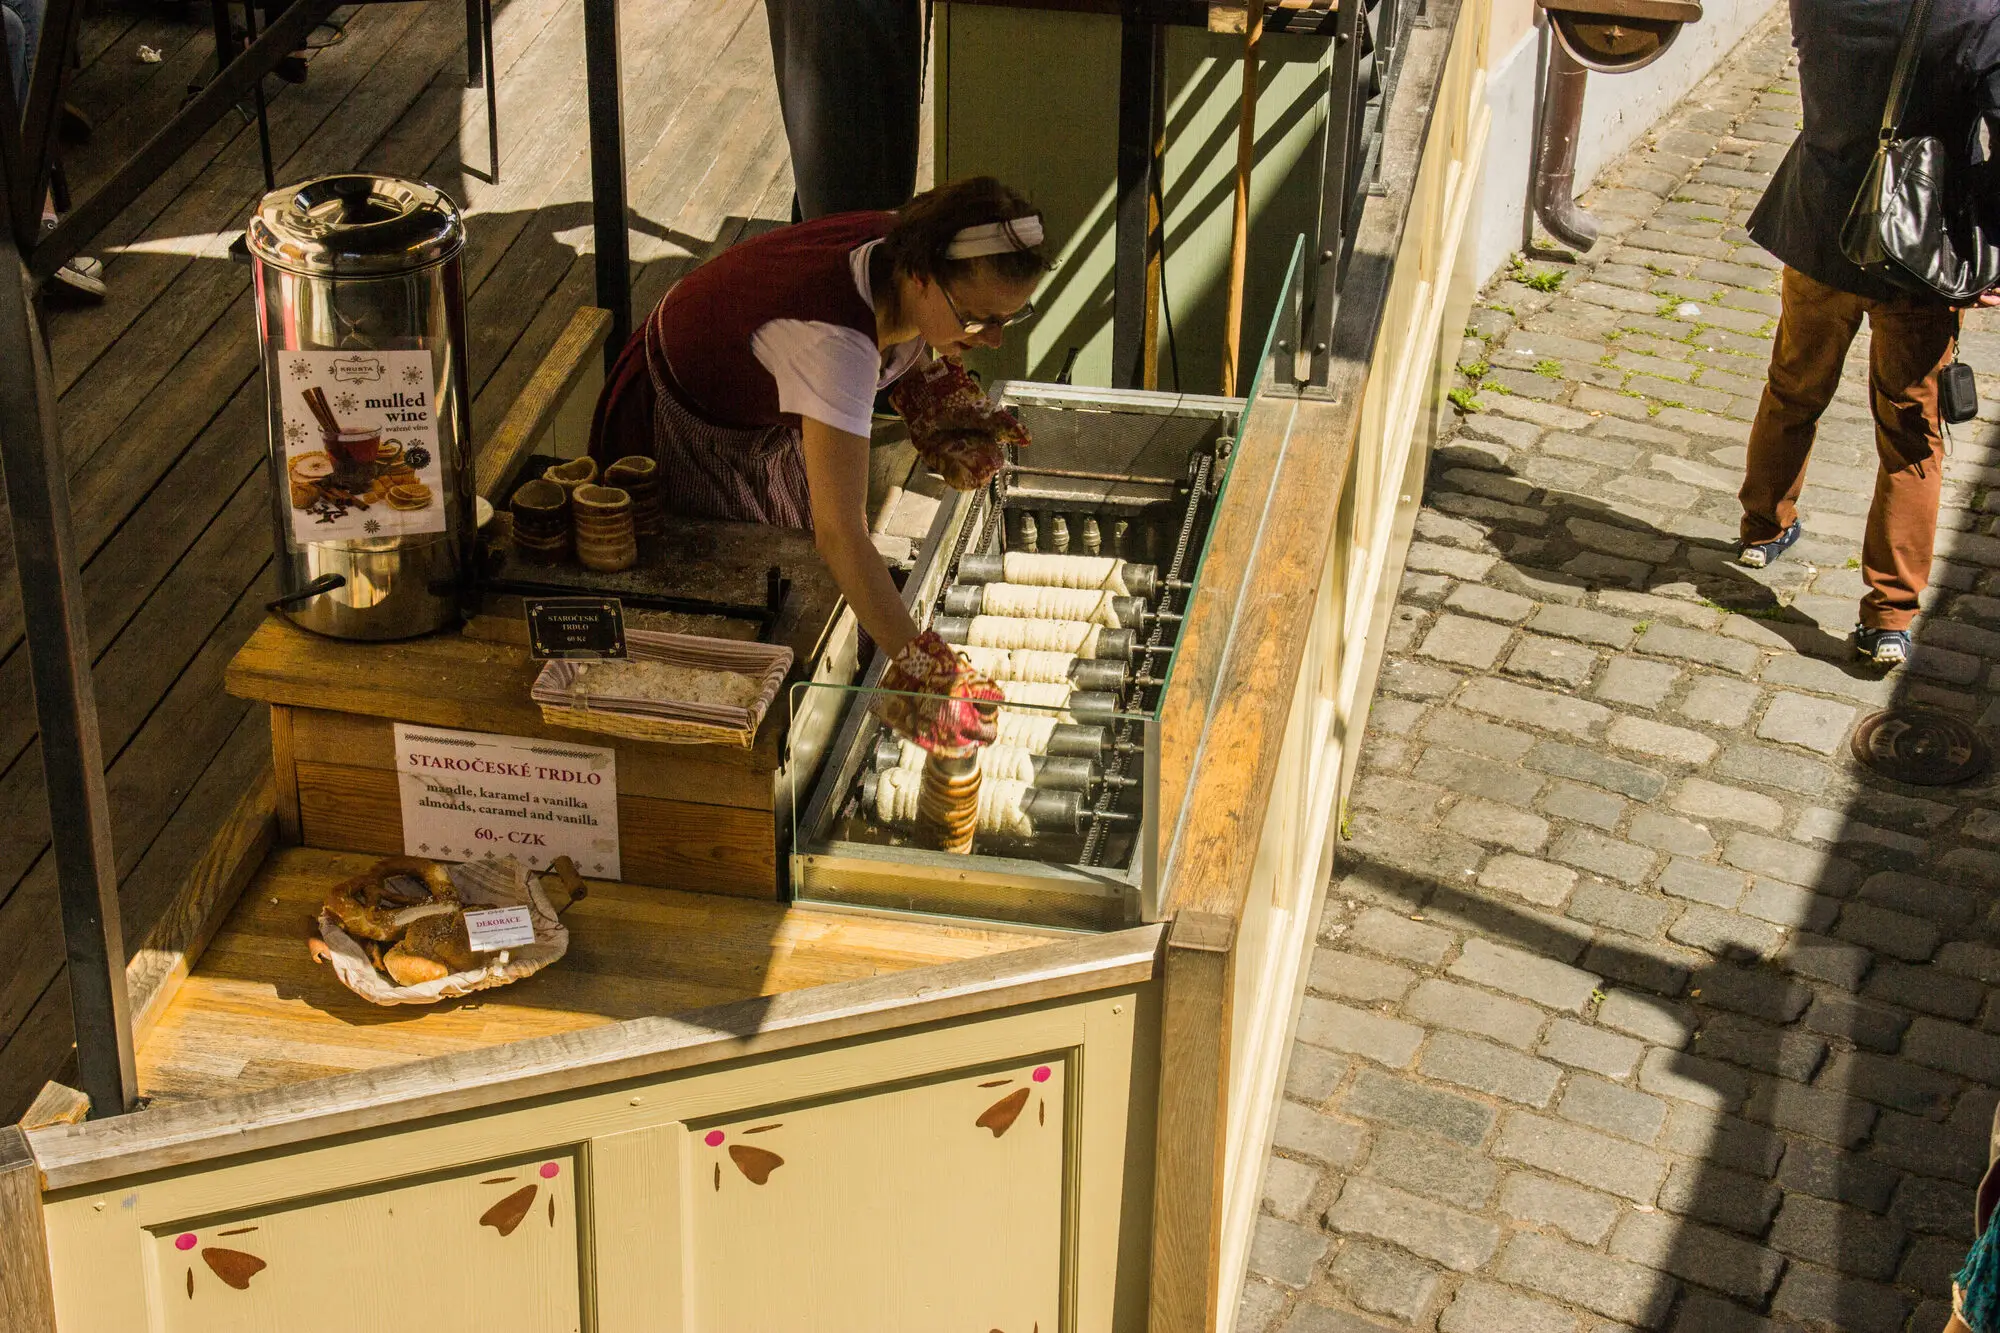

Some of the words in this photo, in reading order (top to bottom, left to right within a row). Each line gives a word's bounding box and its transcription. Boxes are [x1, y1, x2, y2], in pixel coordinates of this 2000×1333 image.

[365, 392, 426, 409] mulled
[386, 409, 428, 422] wine
[562, 623, 589, 631] TRDLO
[409, 753, 531, 778] STAROČESKÉ
[535, 766, 601, 785] TRDLO
[427, 783, 477, 798] mandle,
[480, 787, 530, 803] karamel
[533, 796, 540, 804] a
[542, 797, 588, 809] vanilka
[419, 796, 476, 813] almonds,
[478, 806, 527, 818] caramel
[530, 810, 553, 821] and
[555, 814, 599, 826] vanilla
[508, 831, 547, 846] CZK
[476, 916, 521, 928] DEKORACE
